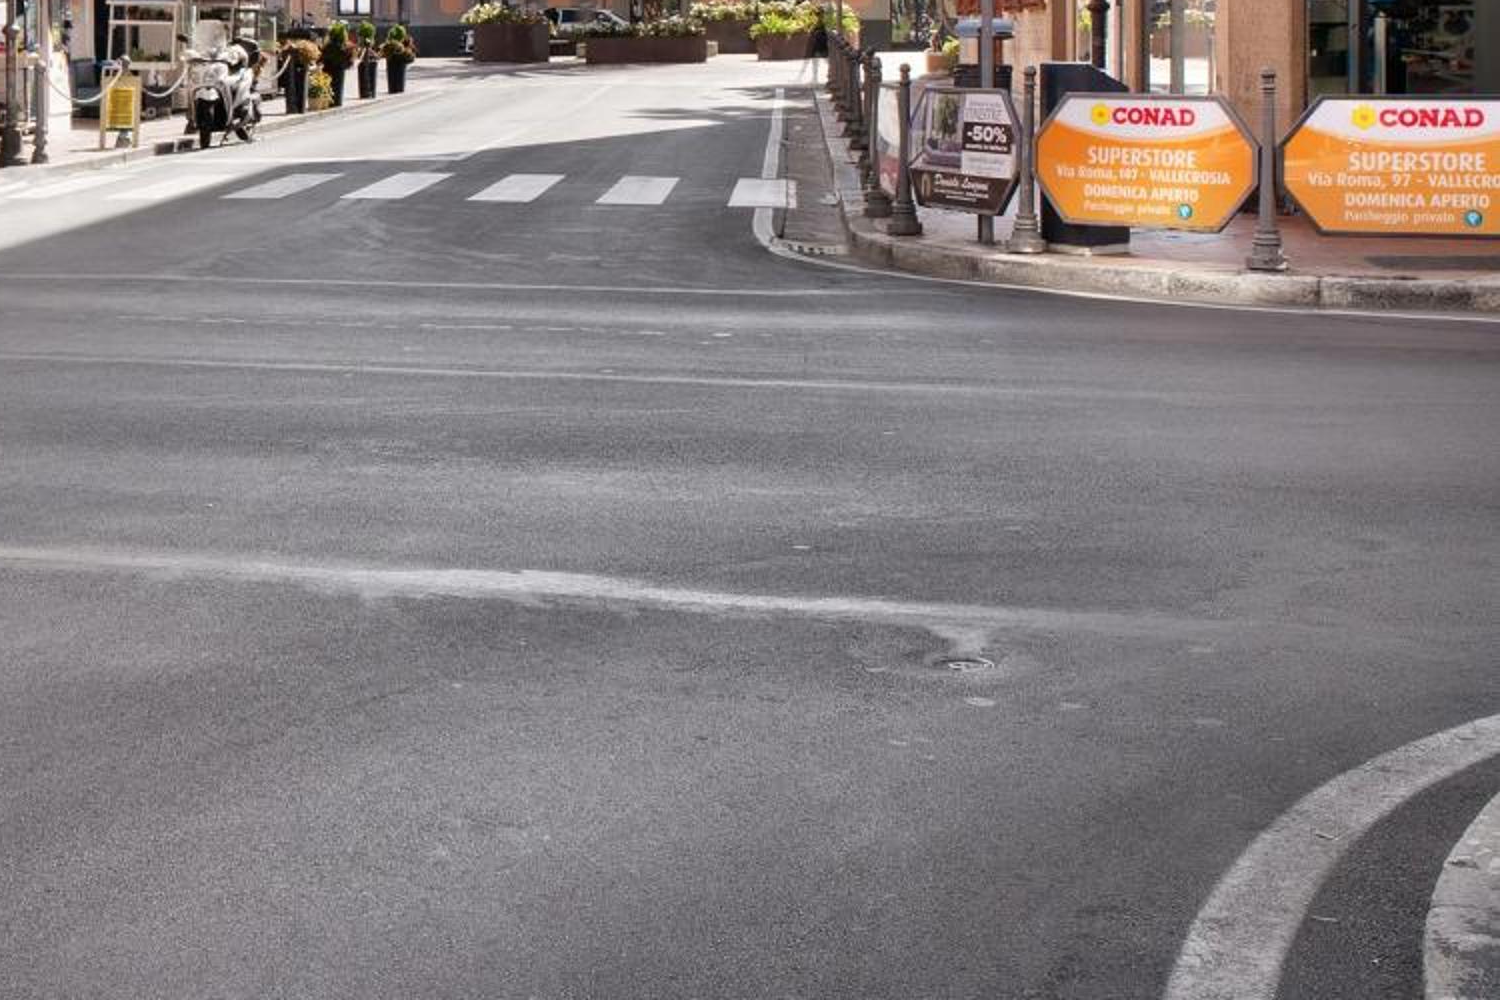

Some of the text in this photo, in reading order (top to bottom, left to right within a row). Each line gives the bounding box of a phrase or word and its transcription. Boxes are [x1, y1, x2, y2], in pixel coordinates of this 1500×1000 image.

[1112, 107, 1196, 127] CONAD
[1379, 108, 1485, 128] CONAD
[966, 125, 1008, 144] -50%
[1087, 145, 1197, 169] SUPERSTORE
[1348, 151, 1487, 171] SUPERSTORE
[1056, 164, 1076, 178] Via
[1078, 165, 1118, 181] Roma,
[1149, 167, 1232, 186] VALLECROSIA
[1308, 171, 1333, 186] Via
[1336, 172, 1386, 190] Roma,
[1391, 173, 1412, 188] 97
[1427, 173, 1500, 190] VALLECRO
[1083, 183, 1200, 203] DOMENICA APERTO
[1344, 192, 1490, 209] DOMENICA APERTO
[1413, 212, 1456, 225] privato
